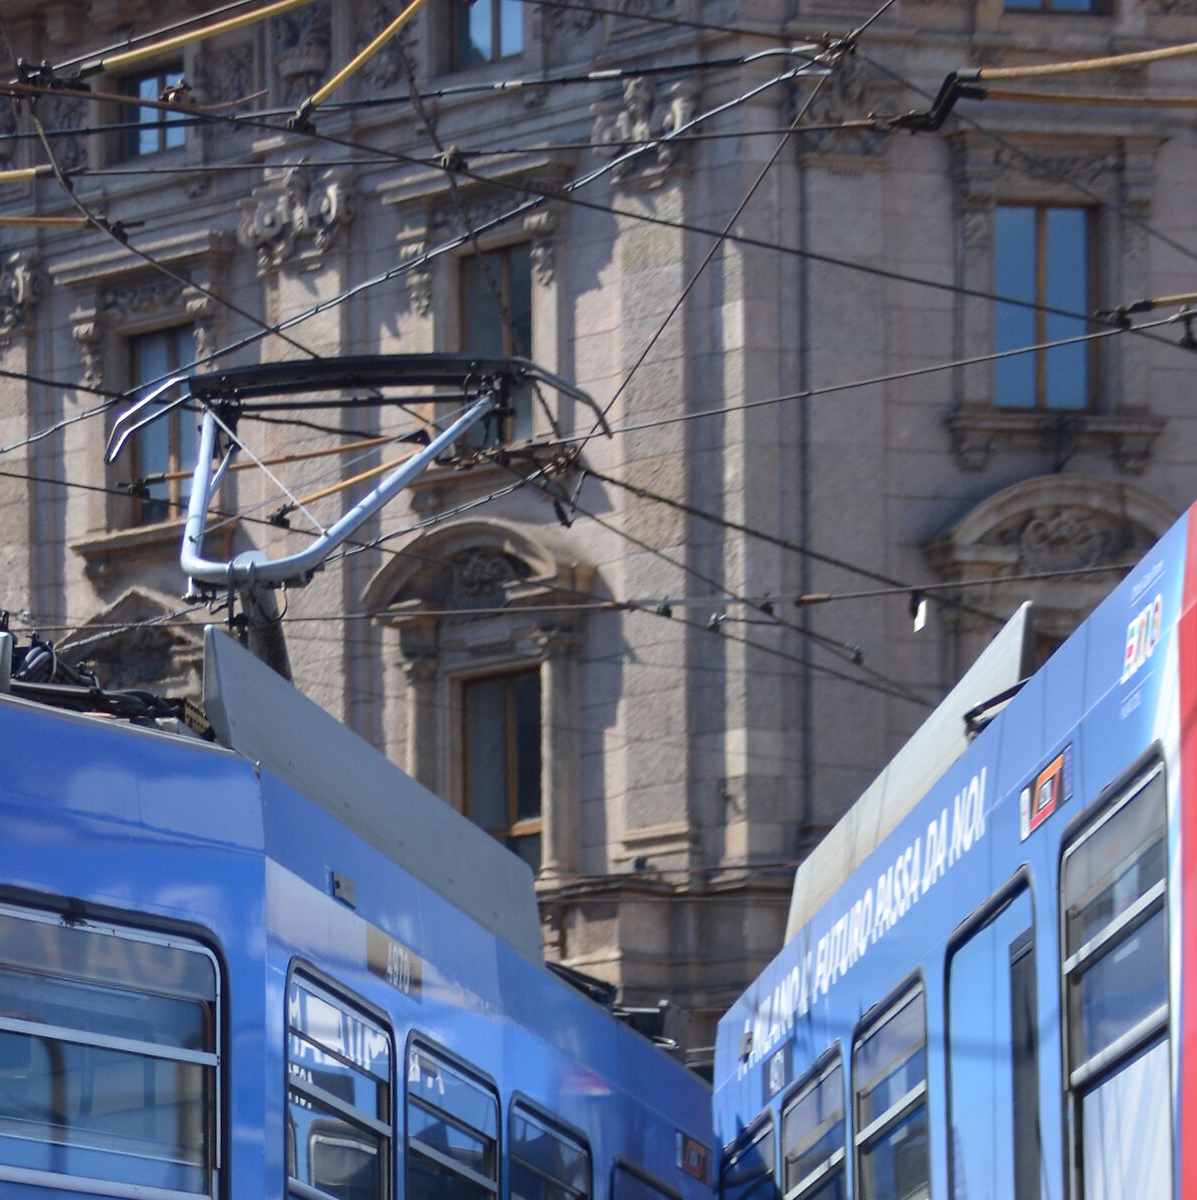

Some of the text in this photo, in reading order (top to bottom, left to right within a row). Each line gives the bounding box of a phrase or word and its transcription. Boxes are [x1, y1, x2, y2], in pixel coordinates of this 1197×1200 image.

[813, 888, 873, 1003] FUTURO
[871, 837, 921, 944] PASSA
[921, 808, 948, 895] DA
[948, 766, 986, 868] NOI
